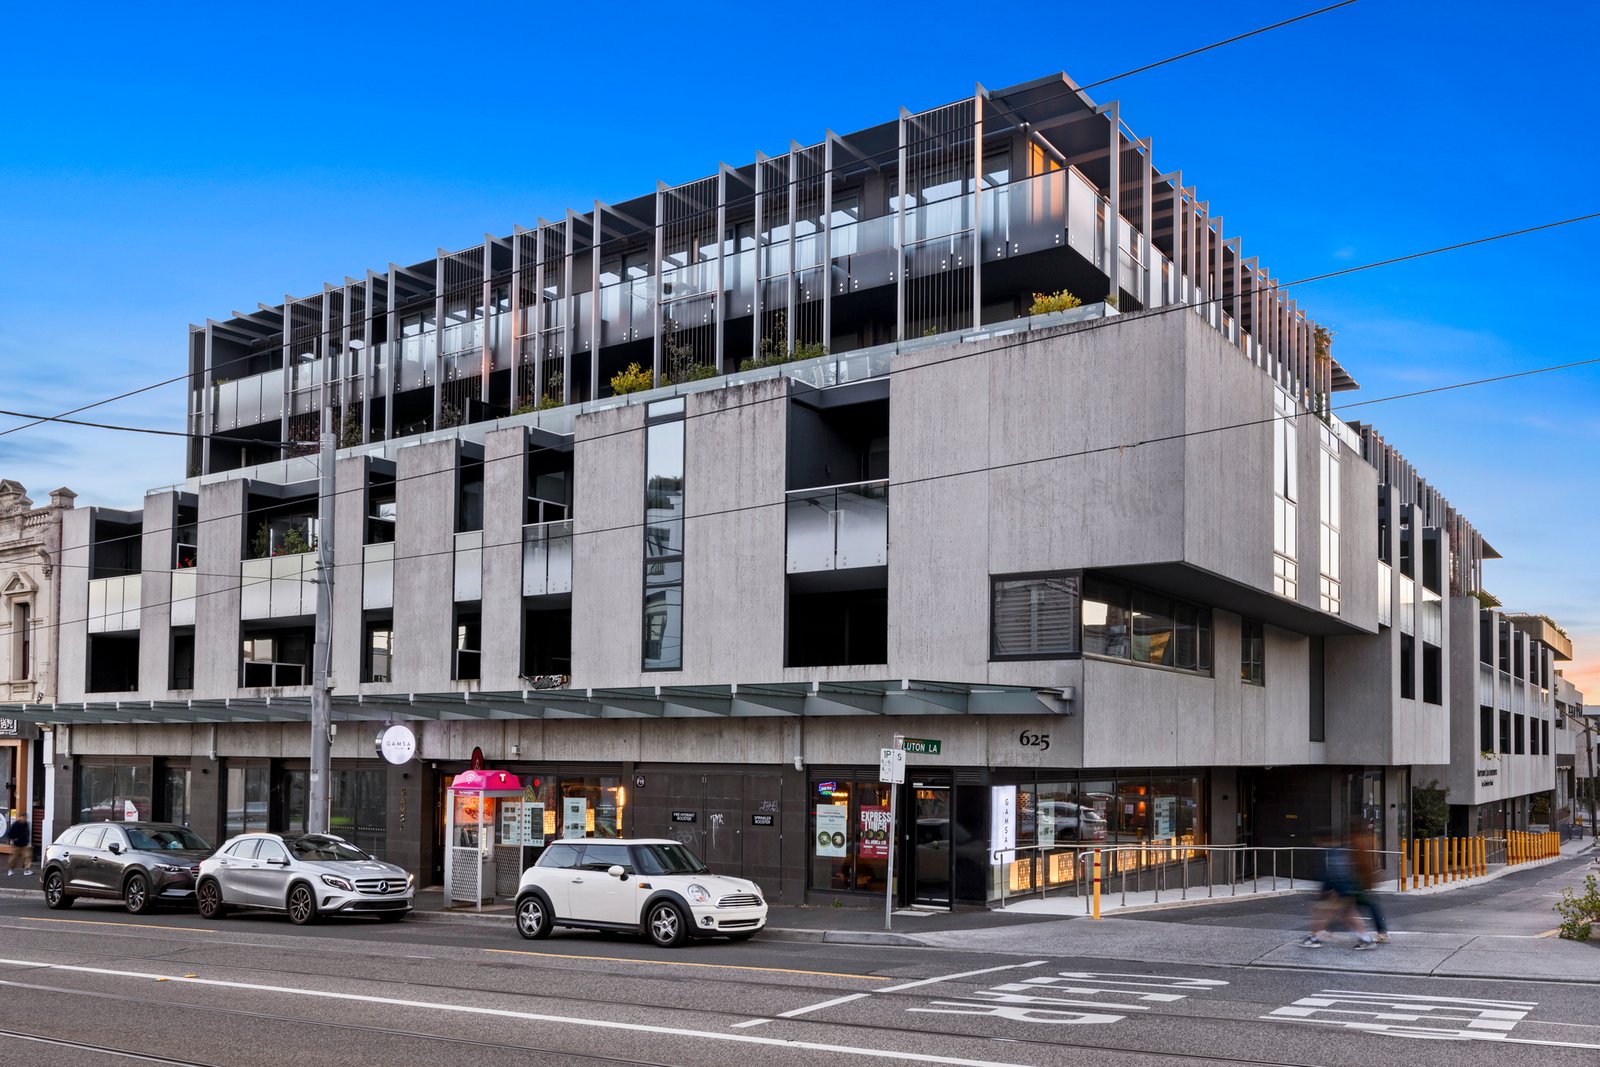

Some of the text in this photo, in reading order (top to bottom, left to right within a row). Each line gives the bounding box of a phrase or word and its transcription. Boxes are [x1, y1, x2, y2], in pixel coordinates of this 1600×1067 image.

[1019, 729, 1050, 751] 625
[902, 742, 926, 752] LUTON
[928, 744, 938, 753] LA
[883, 750, 892, 758] 1P
[500, 773, 506, 782] T
[861, 811, 891, 823] EXPRESS
[864, 821, 887, 833] LUNCH
[906, 971, 1230, 1025] CLEAR
[1260, 988, 1540, 1042] KEEP
